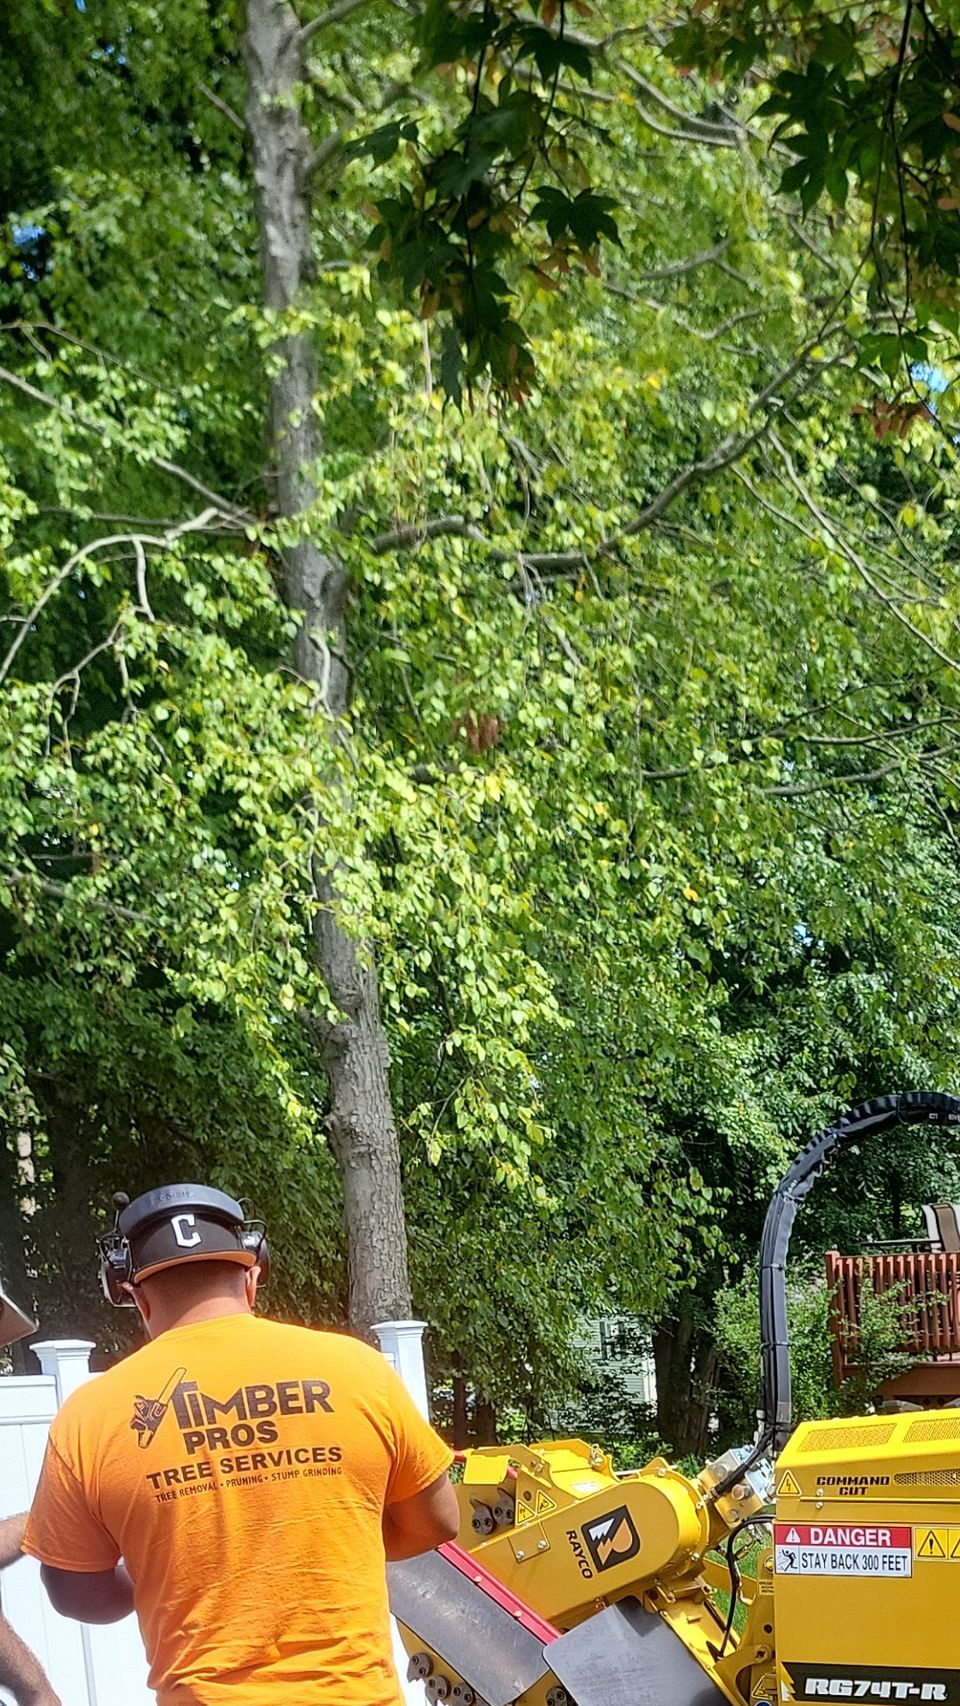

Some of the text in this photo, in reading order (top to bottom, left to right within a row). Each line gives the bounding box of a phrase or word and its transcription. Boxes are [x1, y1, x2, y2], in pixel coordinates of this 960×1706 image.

[171, 1213, 202, 1248] C
[171, 1380, 335, 1430] TIMBER
[183, 1420, 279, 1456] PROS
[146, 1446, 343, 1490] TREE SERVICES
[155, 1466, 343, 1503] TREE REMOVAL PRUNING STUMP GRINDING
[816, 1476, 890, 1486] COMMAND
[839, 1486, 869, 1496] CUT
[810, 1527, 891, 1546] DANGER
[566, 1529, 594, 1580] RAYCO
[801, 1552, 908, 1572] STAY BACK 300 FEET
[804, 1677, 948, 1701] RG74T-R
